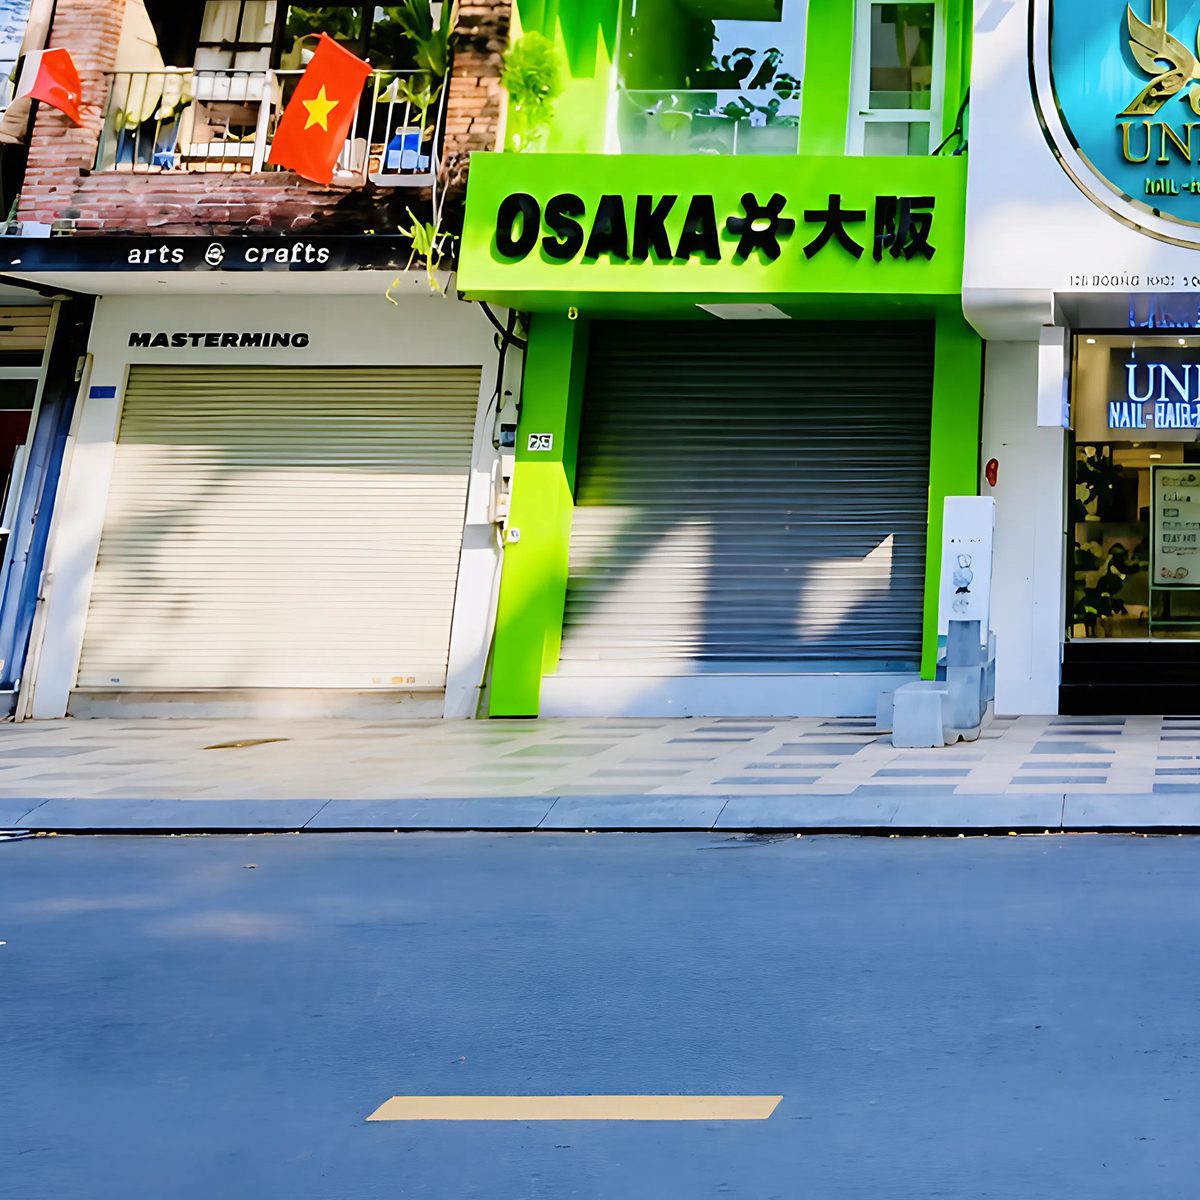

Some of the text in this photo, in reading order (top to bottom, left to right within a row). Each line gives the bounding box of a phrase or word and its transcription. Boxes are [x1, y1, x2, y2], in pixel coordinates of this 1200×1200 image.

[495, 192, 937, 262] OSAKA 大阪
[127, 244, 185, 264] arts
[244, 242, 331, 264] crafts
[127, 331, 310, 349] MASTERMING
